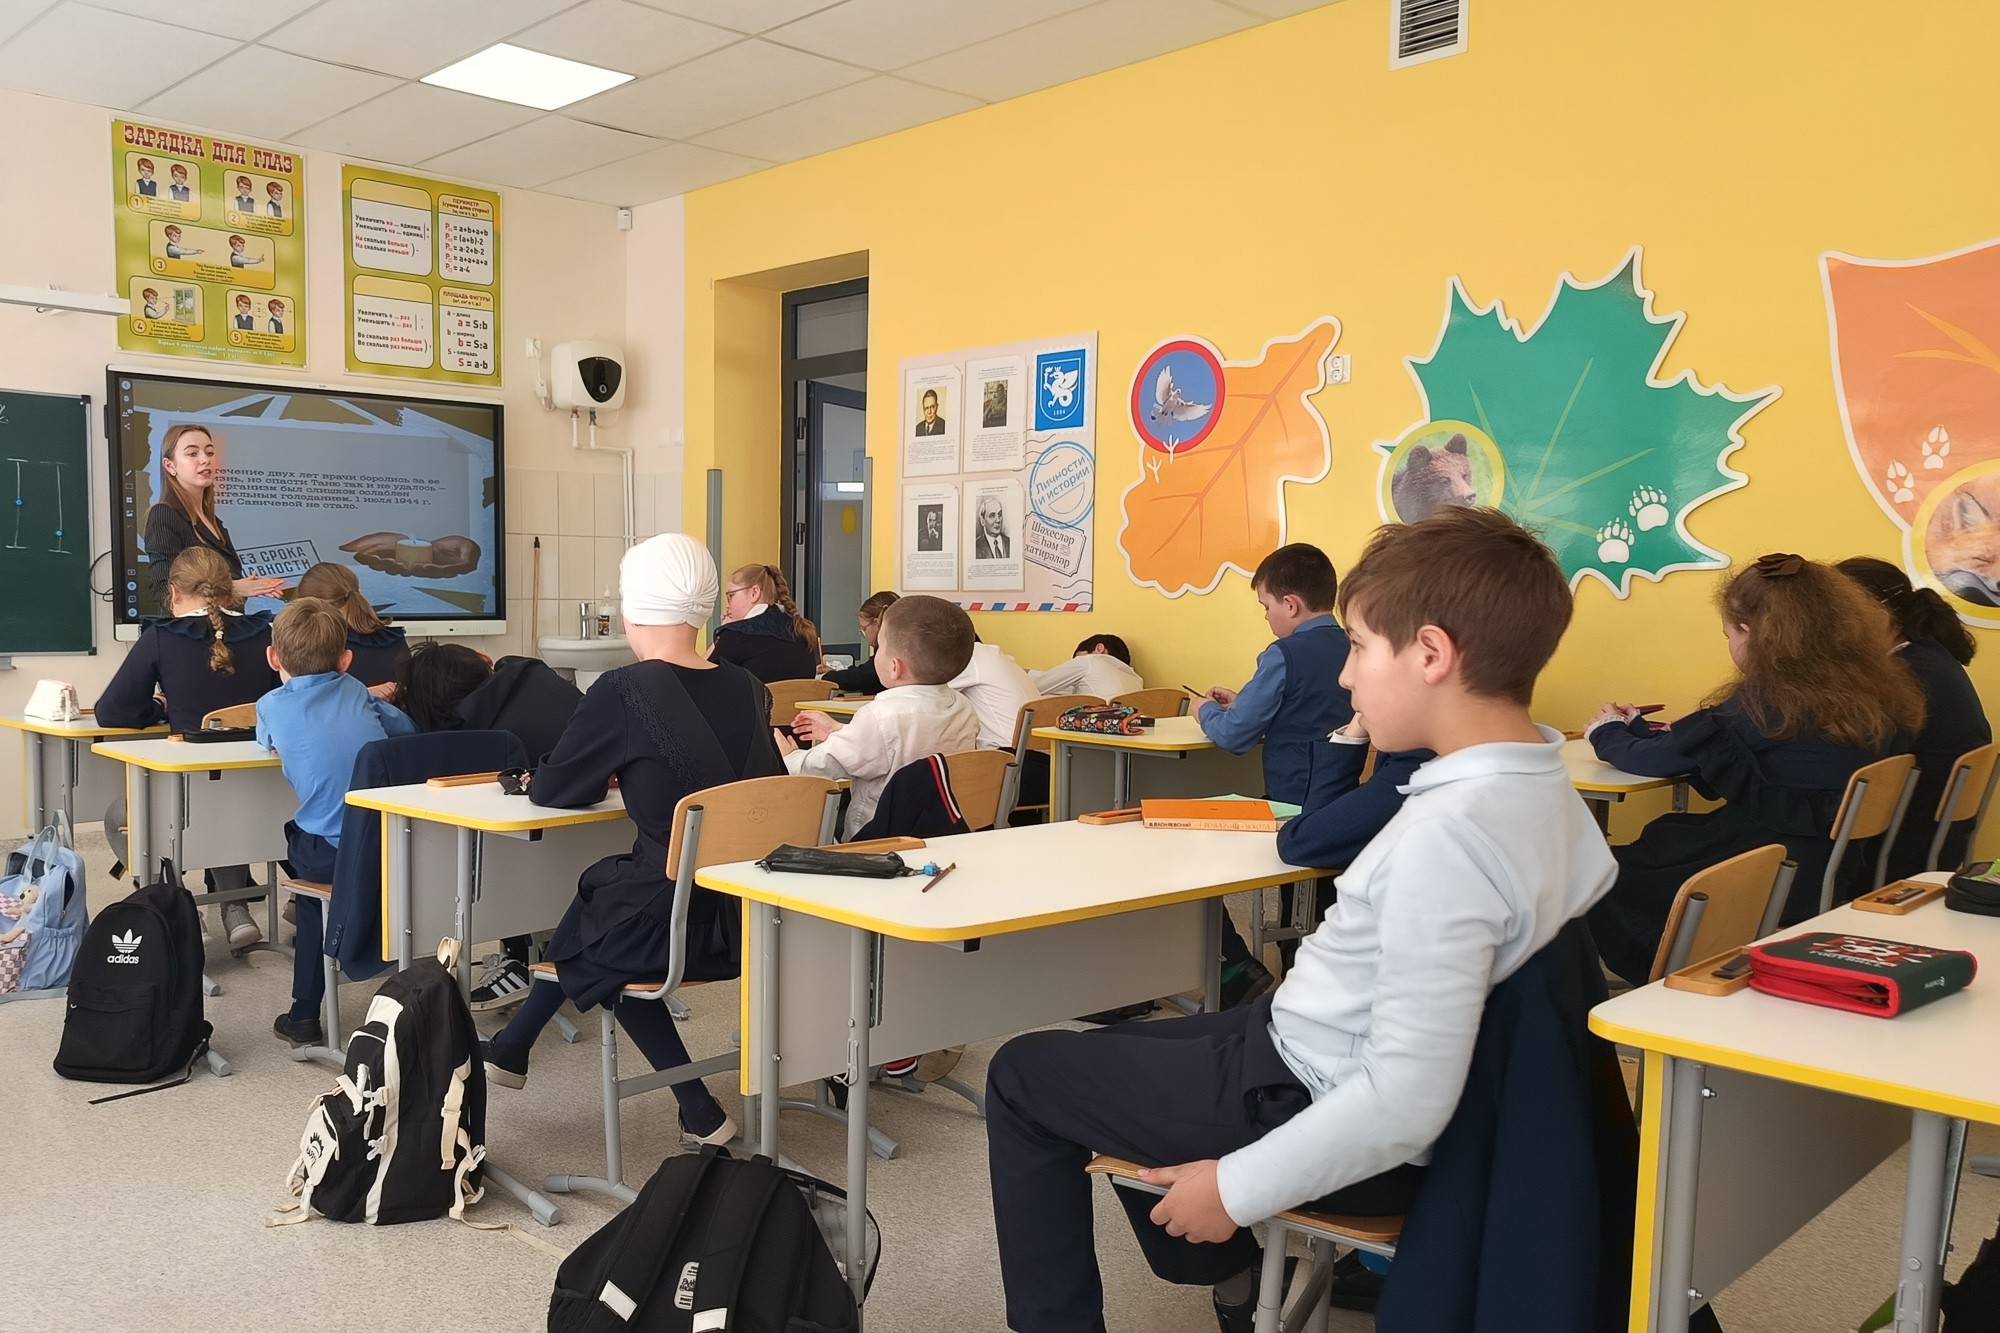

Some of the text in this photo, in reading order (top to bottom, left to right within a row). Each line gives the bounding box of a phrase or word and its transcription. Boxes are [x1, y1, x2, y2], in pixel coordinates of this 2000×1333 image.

[124, 125, 292, 173] ЗАРЯДКА ДЛЯ ГЛАЗ
[453, 198, 479, 207] ПЕРИМЕТР
[355, 215, 385, 224] Увеличить
[355, 223, 387, 233] Уменьшить
[443, 291, 468, 299] ПЛОЩАДЬ
[358, 309, 388, 318] Увеличить
[358, 317, 390, 326] Уменьшить
[458, 338, 463, 347] b
[458, 358, 464, 366] S
[360, 475, 410, 484] боролись
[1036, 456, 1085, 494] Личности
[219, 484, 277, 492] организм
[359, 488, 410, 497] ослаблен
[1038, 467, 1090, 506] и истории
[237, 498, 302, 507] Савичевой
[281, 494, 352, 502] голоданием.
[1031, 520, 1074, 546] Шәхесләр
[1041, 536, 1059, 551] һәм
[239, 546, 306, 565] ЕЗ СРОКА
[1024, 543, 1070, 568] хатирәләр
[107, 954, 139, 964] adidas
